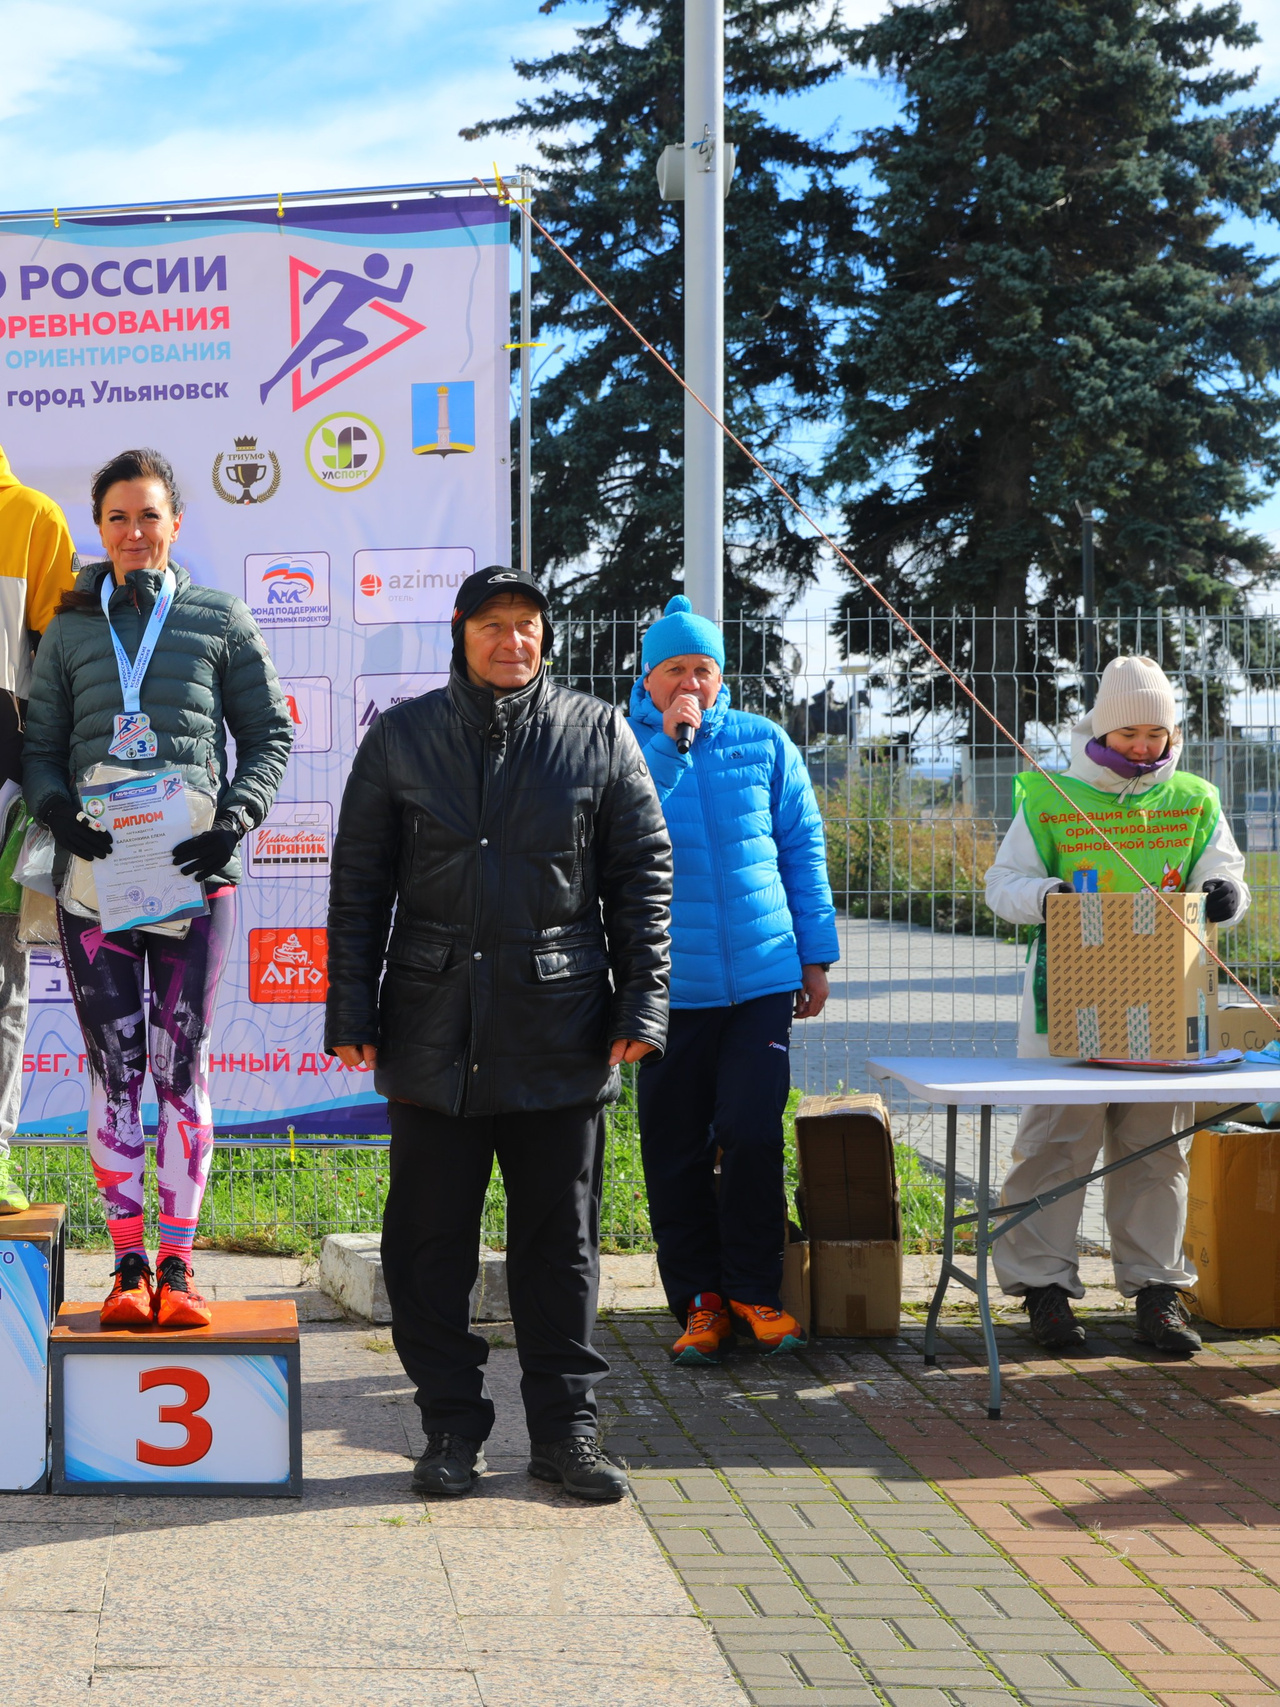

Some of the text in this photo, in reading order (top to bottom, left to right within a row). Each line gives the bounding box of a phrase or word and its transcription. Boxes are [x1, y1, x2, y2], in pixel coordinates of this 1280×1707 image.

[20, 255, 227, 300] РОССИИ
[5, 341, 231, 369] ОРИЕНТИРОВАНИЯ
[7, 388, 85, 413] город
[90, 380, 229, 404] Ульяновск
[227, 453, 265, 462] ТРИУМФ
[322, 469, 368, 480] УЛСПОРТ
[388, 570, 470, 589] azimut
[251, 605, 328, 616] ФОНД ПОДДЕРЖКИ
[137, 740, 147, 753] 3
[113, 810, 164, 830] ДИПЛОМ
[1038, 811, 1122, 824] Федерация
[1066, 823, 1188, 839] ориентирования
[255, 829, 326, 856] Ульяновский
[266, 843, 326, 855] ПРЯНИК
[136, 1365, 213, 1468] 3
